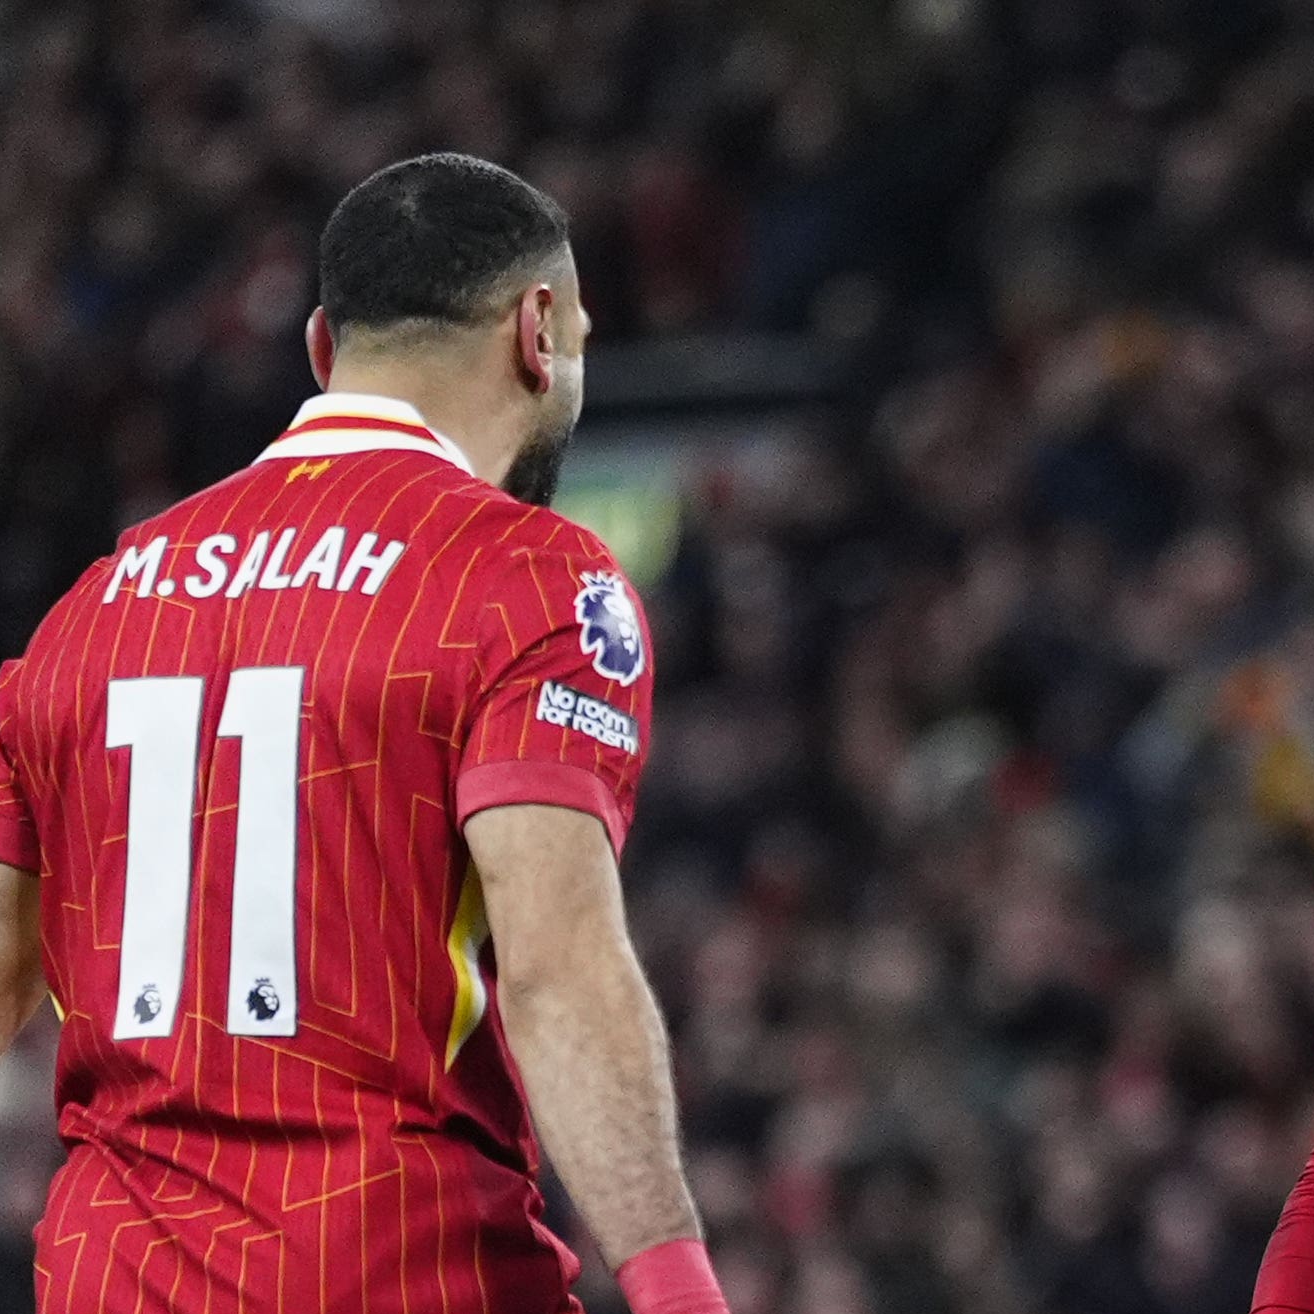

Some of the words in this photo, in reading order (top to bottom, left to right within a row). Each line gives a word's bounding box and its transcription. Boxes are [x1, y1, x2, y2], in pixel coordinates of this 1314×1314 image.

[536, 704, 572, 728] for
[572, 714, 638, 756] racism
[539, 680, 575, 711] No
[575, 696, 631, 734] room
[105, 666, 305, 1040] 11
